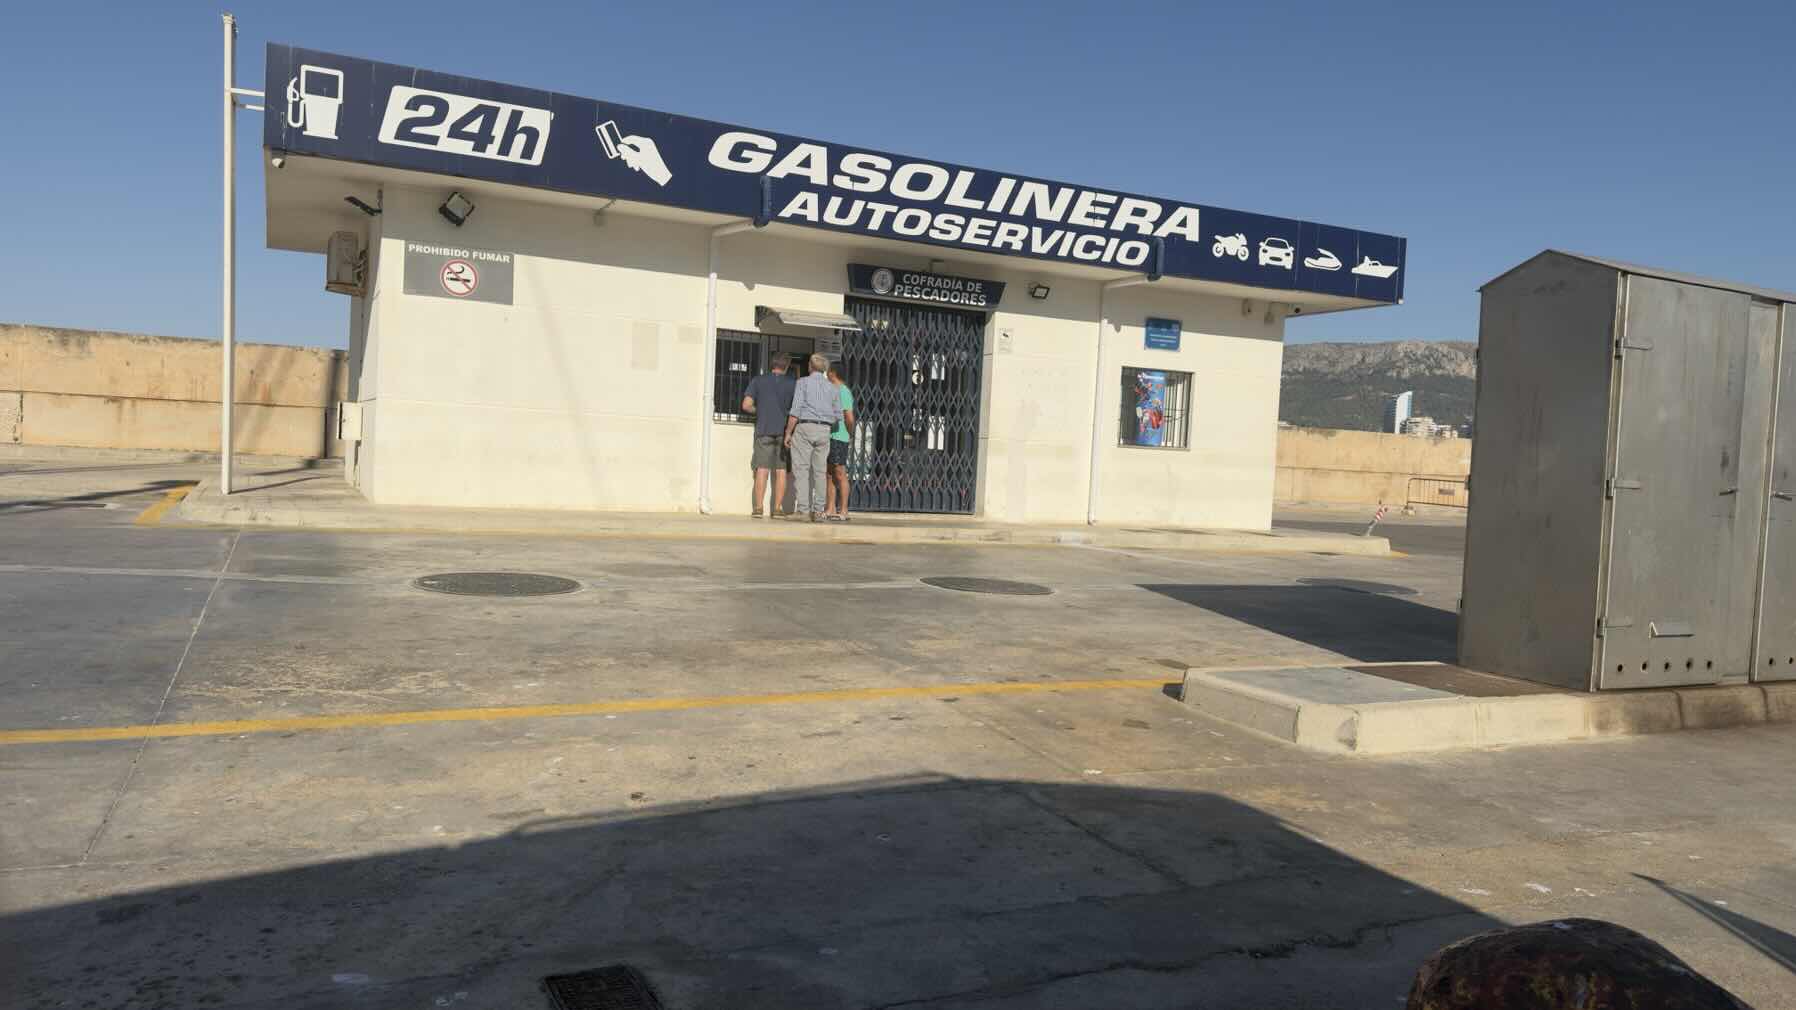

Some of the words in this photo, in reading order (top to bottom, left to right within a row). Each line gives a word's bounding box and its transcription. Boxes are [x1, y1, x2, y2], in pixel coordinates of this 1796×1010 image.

[394, 94, 540, 161] 24h
[707, 131, 1201, 242] GASOLINERA
[779, 191, 1151, 267] AUTOSERVICIO
[408, 244, 469, 258] PROHIBIDO
[472, 251, 510, 263] FUMAR
[893, 284, 987, 306] PESCADORES
[966, 281, 983, 293] DE
